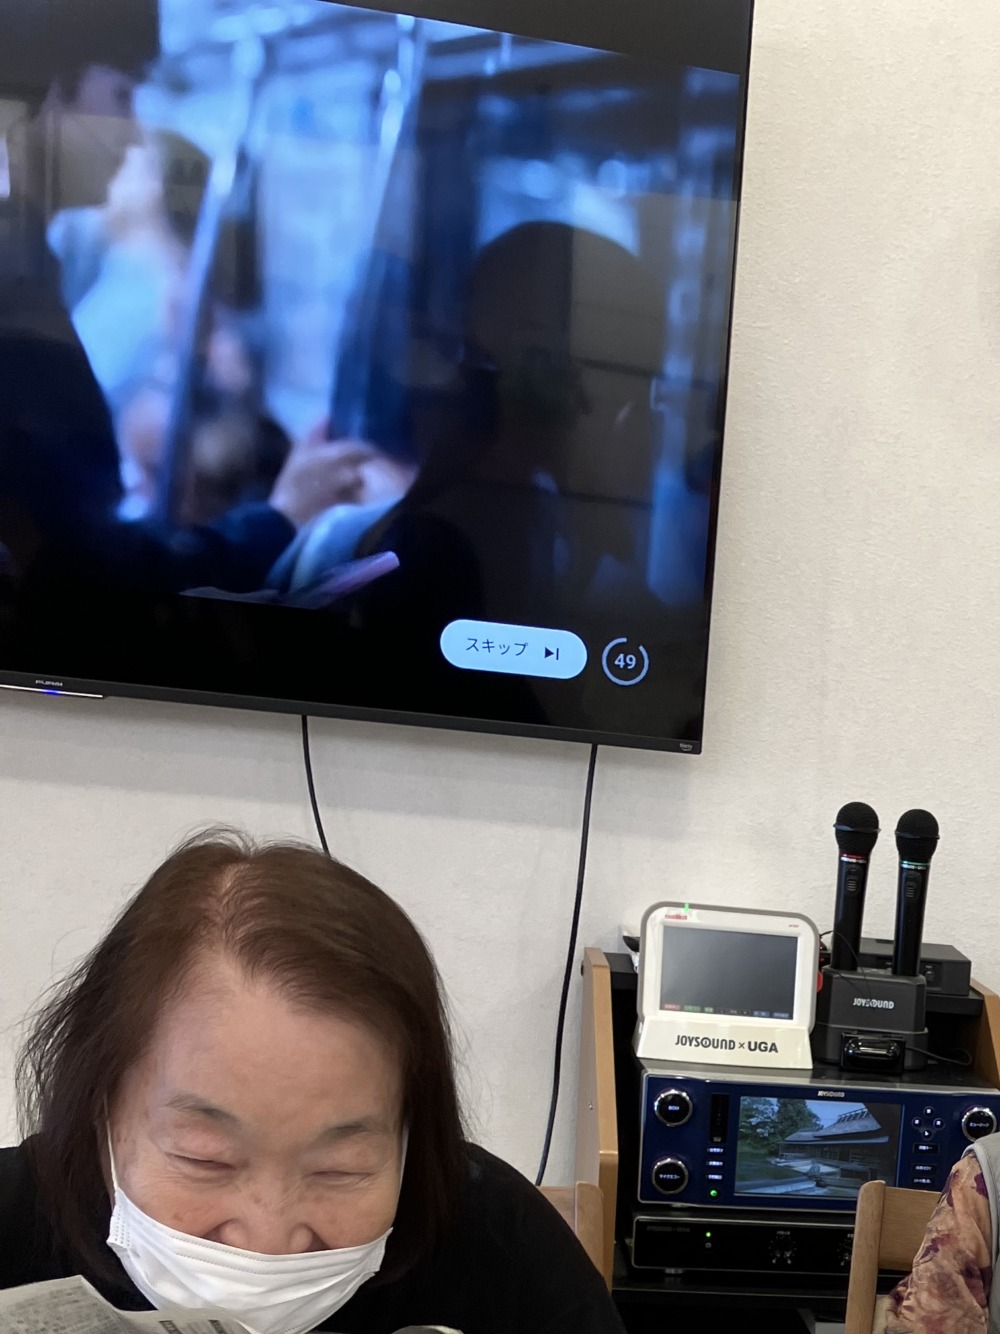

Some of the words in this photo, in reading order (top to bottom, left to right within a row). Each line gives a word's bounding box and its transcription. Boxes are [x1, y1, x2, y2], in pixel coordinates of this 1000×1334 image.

[465, 636, 529, 658] スキップ
[613, 653, 636, 670] 49
[853, 998, 894, 1010] JOYSOUND
[675, 1035, 736, 1050] JOYSOUND
[747, 1041, 779, 1054] UGA
